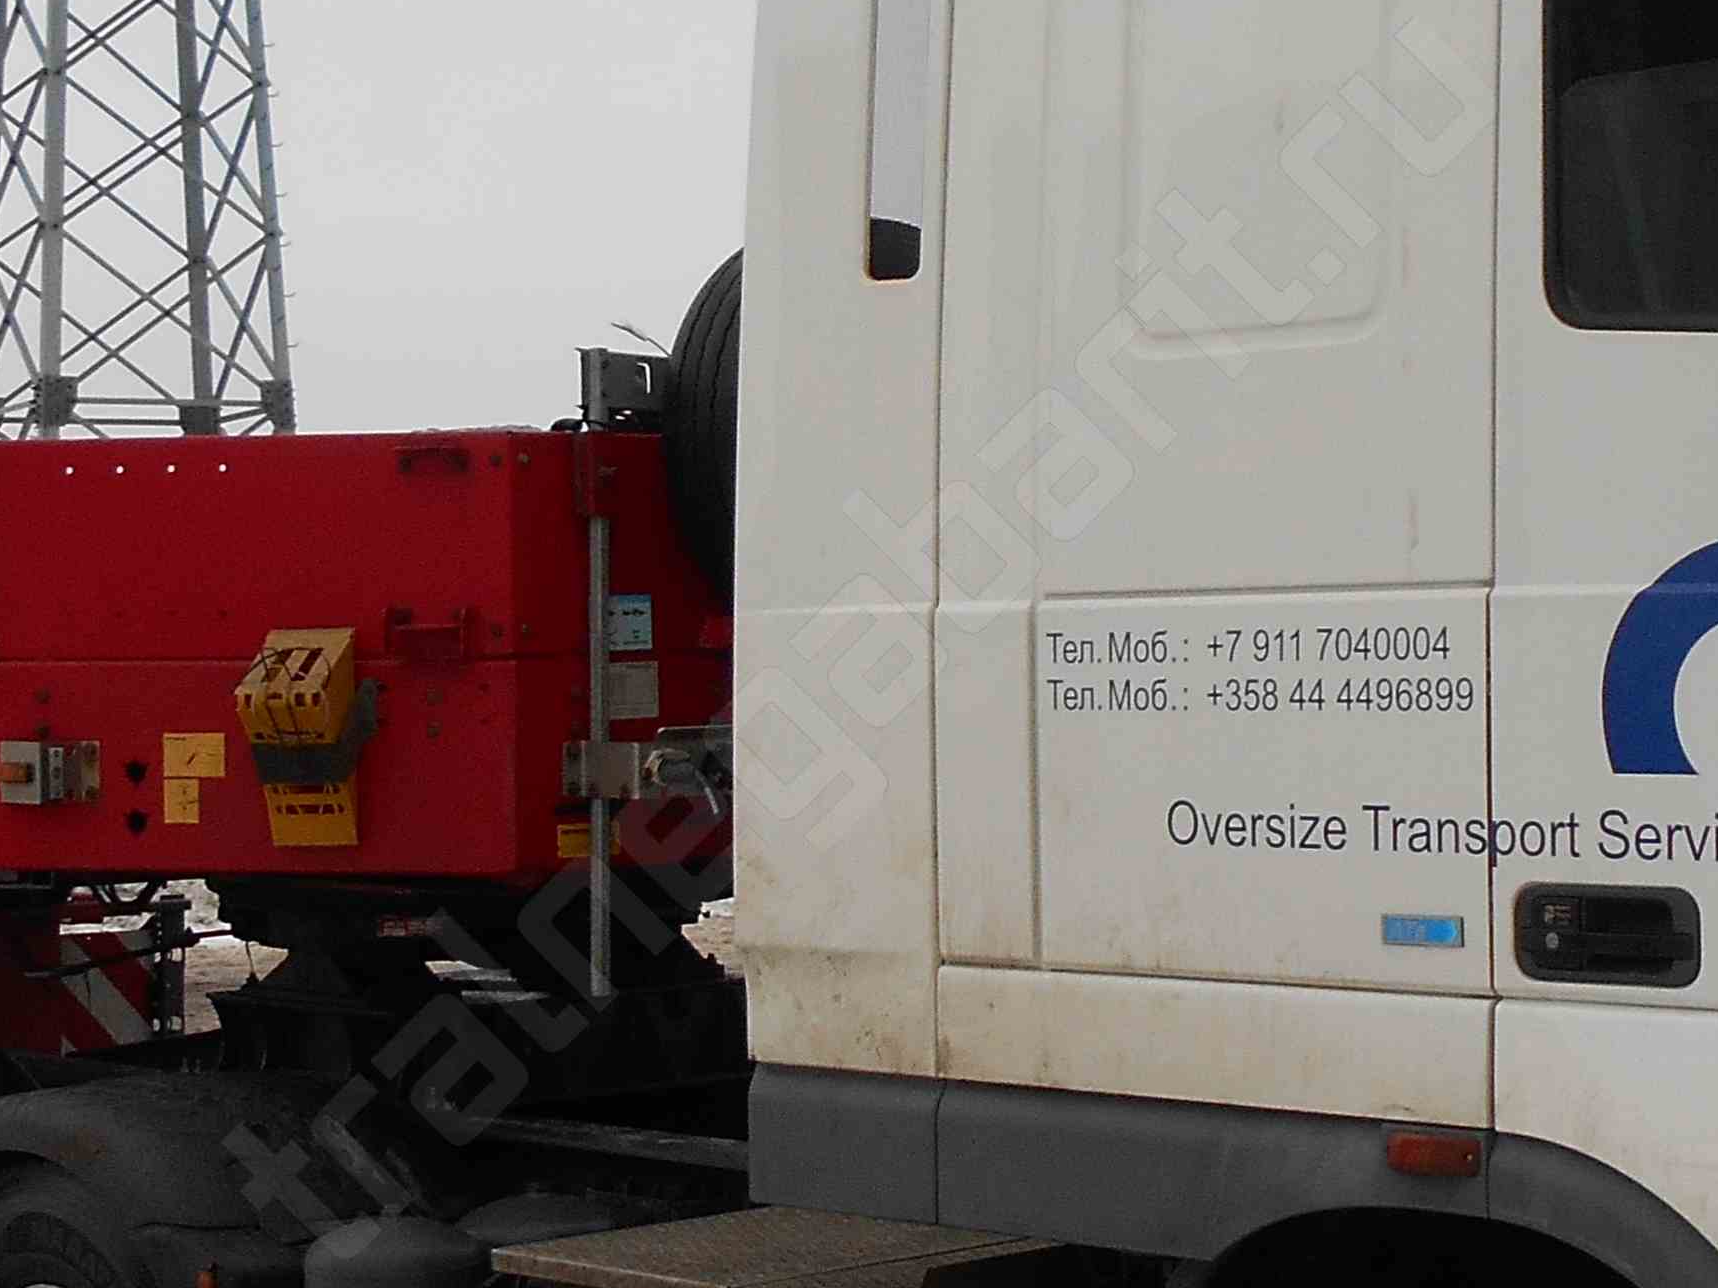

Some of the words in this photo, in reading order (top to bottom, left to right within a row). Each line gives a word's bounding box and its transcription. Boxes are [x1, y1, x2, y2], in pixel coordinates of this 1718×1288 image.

[1207, 629, 1242, 662] +7
[1253, 628, 1301, 662] 911
[1316, 626, 1451, 662] 7040004
[1207, 678, 1278, 711] +358
[1289, 678, 1325, 711] 44
[1337, 677, 1474, 711] 4496899
[1167, 800, 1348, 850] Oversize
[1362, 805, 1580, 867] Transport
